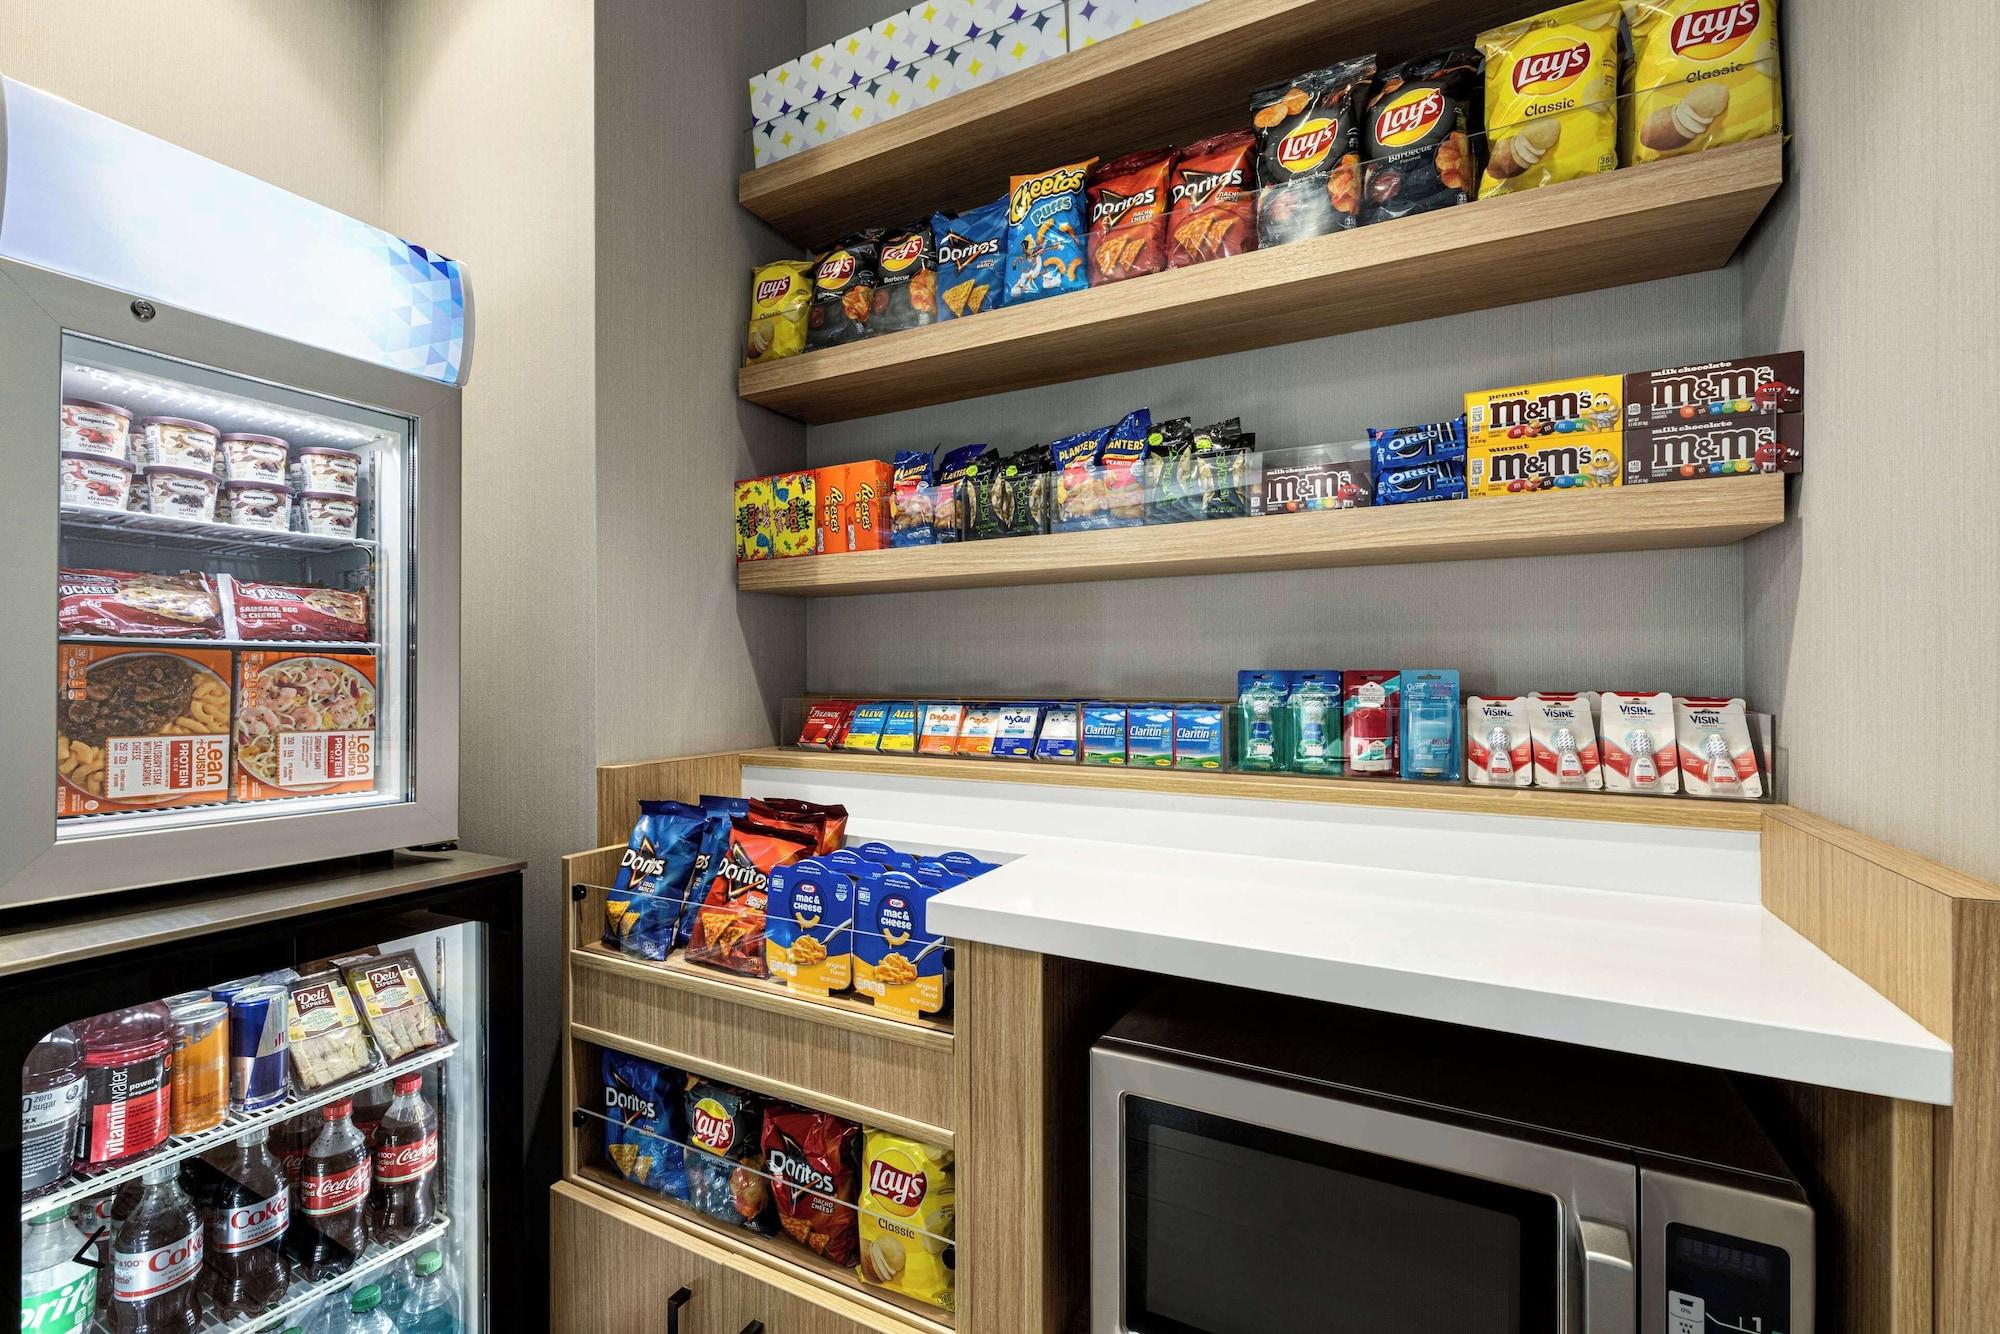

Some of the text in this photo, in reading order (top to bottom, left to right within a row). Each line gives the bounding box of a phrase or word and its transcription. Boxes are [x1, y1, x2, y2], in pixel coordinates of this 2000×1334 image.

[1677, 2, 1757, 49] Lay's
[1517, 47, 1586, 87] Lay's
[1686, 62, 1744, 83] Classic
[1380, 91, 1440, 138] Lay's
[1524, 97, 1575, 117] Classic
[1283, 121, 1336, 160] Lay's
[1388, 145, 1432, 163] Barbecue
[1010, 171, 1085, 224] Cheetos
[1173, 170, 1242, 204] Doritos
[1093, 188, 1155, 222] Doritos
[1133, 209, 1153, 218] NACHO
[883, 238, 920, 261] Lay's
[939, 239, 998, 264] Doritos
[818, 256, 852, 281] Lay's
[758, 277, 788, 301] Lay's
[1651, 361, 1732, 377] milk chocolate
[1488, 389, 1529, 400] peanut
[1651, 367, 1774, 411] m&m's
[1490, 391, 1592, 428] m&m's
[1652, 420, 1733, 435] milk chocolate
[1106, 438, 1144, 451] ANTERS
[1388, 430, 1437, 451] OREO
[1652, 428, 1775, 469] m&m's
[1388, 467, 1437, 485] OREO
[1490, 447, 1592, 481] m&m's
[1267, 472, 1350, 504] m&m's
[830, 486, 843, 533] Reese's
[861, 482, 875, 531] Reese's
[858, 709, 884, 718] ALEVE
[1005, 715, 1031, 725] NyQuil
[1543, 708, 1575, 718] VISINE
[1690, 715, 1726, 725] VISIN
[1085, 725, 1115, 736] Claritin
[1130, 726, 1161, 737] Claritin
[1177, 728, 1209, 738] Claritin
[132, 742, 141, 761] CHEESE
[154, 741, 162, 785] SALISBURY STEAK
[207, 740, 223, 785] Lean
[334, 737, 343, 776] PROTEIN
[348, 741, 356, 776] cuisine
[357, 735, 370, 775] Lean
[179, 743, 189, 786] PROTEIN
[196, 746, 206, 787] cuisine
[718, 857, 768, 892] Dorito
[796, 894, 820, 904] mac &
[884, 909, 909, 921] mac &
[372, 972, 399, 985] Deli
[297, 989, 328, 1005] Deli
[301, 998, 330, 1010] EXPRESS
[33, 1100, 56, 1112] sugar
[34, 1093, 53, 1103] zero
[606, 1087, 656, 1118] Doritos
[769, 1150, 834, 1193] Doritos
[871, 1162, 924, 1204] Lay's
[231, 1197, 287, 1229] Coke
[811, 1203, 834, 1214] CHEESE
[813, 1197, 834, 1207] NACHO
[878, 1217, 915, 1239] Classic
[21, 1277, 95, 1329] prite
